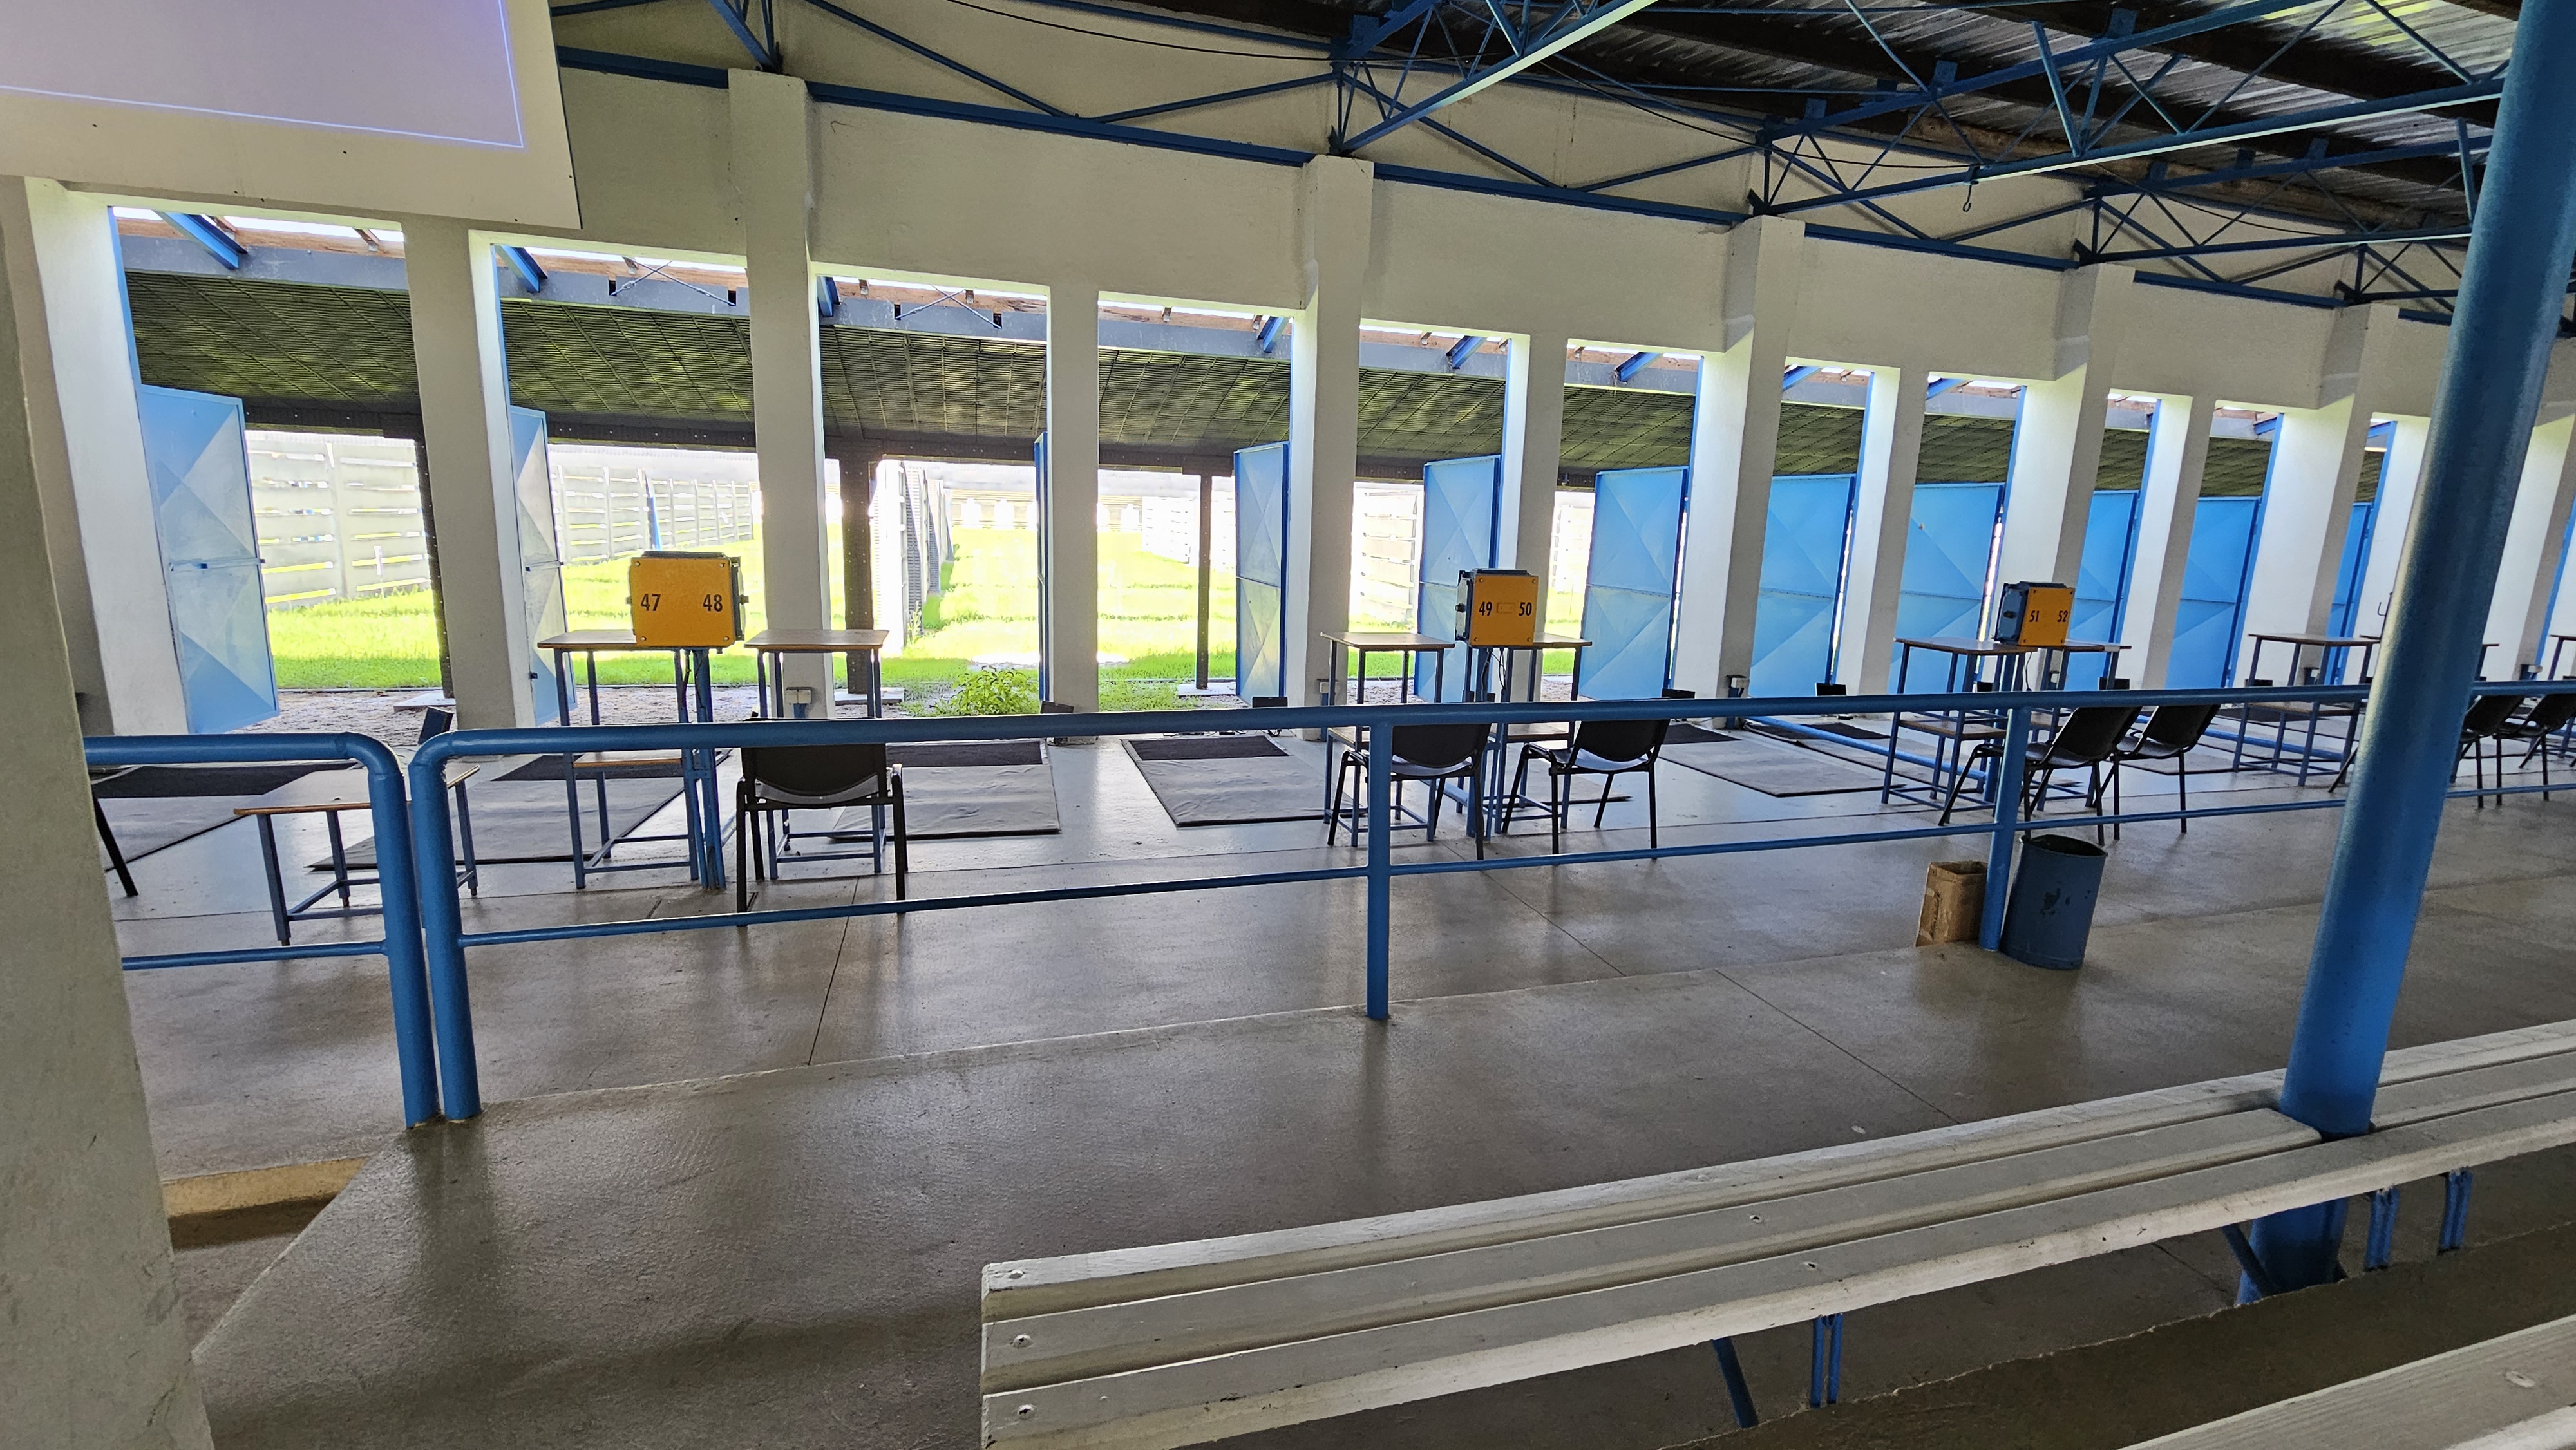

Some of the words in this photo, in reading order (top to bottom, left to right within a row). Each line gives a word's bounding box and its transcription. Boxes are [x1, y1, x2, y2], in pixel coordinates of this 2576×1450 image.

[641, 593, 661, 612] 47
[703, 594, 723, 612] 48
[1479, 601, 1493, 616] 49
[1518, 601, 1532, 616] 50
[2029, 610, 2040, 623] 51
[2057, 610, 2068, 623] 52
